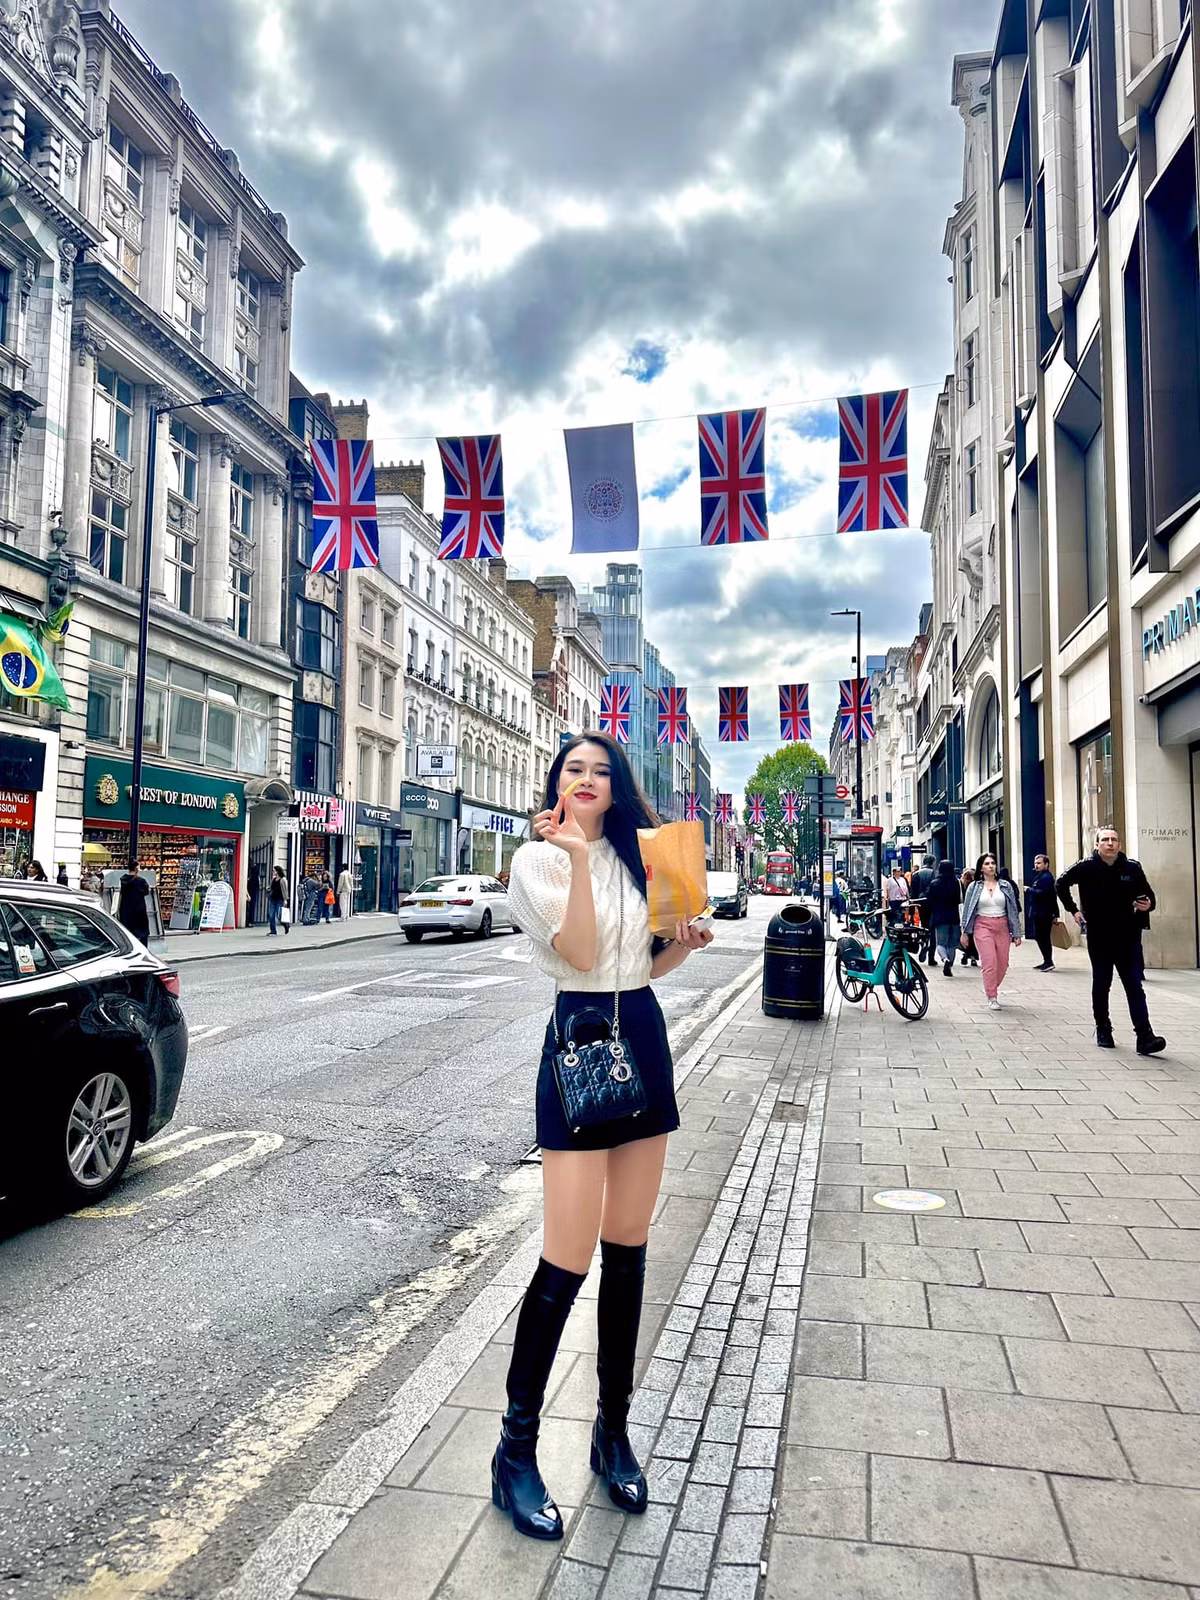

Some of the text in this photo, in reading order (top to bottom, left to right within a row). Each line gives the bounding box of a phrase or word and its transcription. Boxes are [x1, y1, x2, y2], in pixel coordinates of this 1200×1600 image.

[165, 790, 178, 804] OF
[181, 792, 218, 810] LONDON
[485, 814, 514, 834] FFICE
